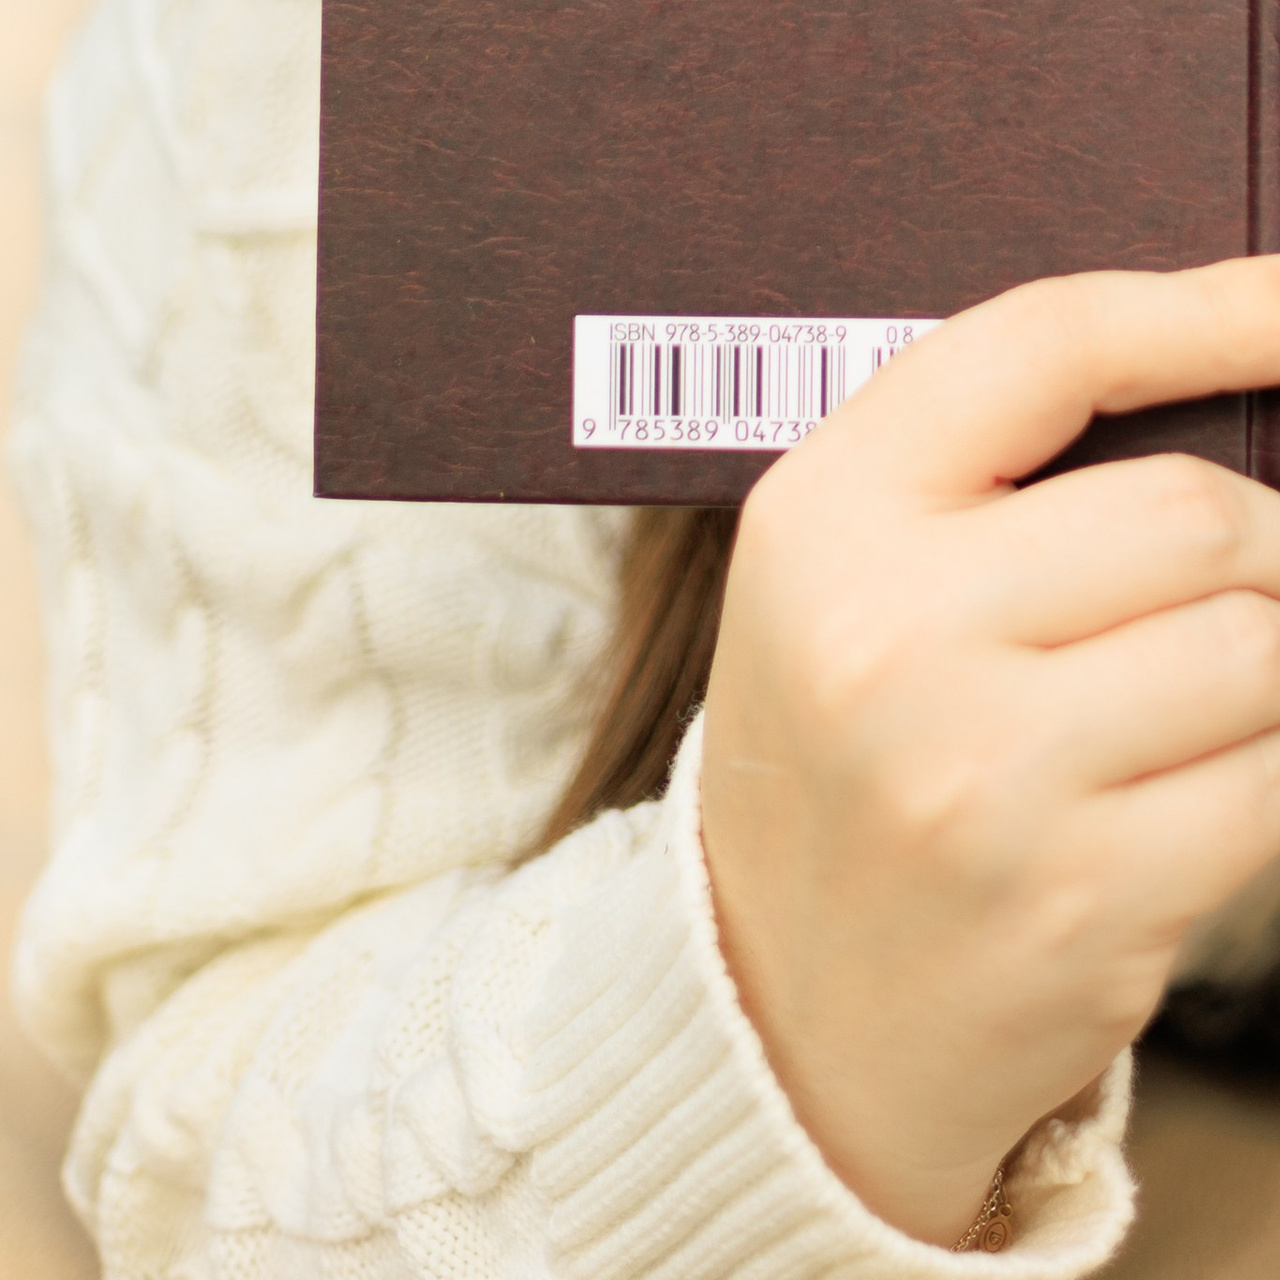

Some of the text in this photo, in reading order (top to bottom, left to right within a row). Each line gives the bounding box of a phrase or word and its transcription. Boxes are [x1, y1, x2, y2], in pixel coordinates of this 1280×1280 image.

[608, 323, 656, 342] ISBN
[665, 323, 848, 344] 978-5-389-04738-9
[581, 418, 597, 440] 9
[617, 419, 719, 442] 785389
